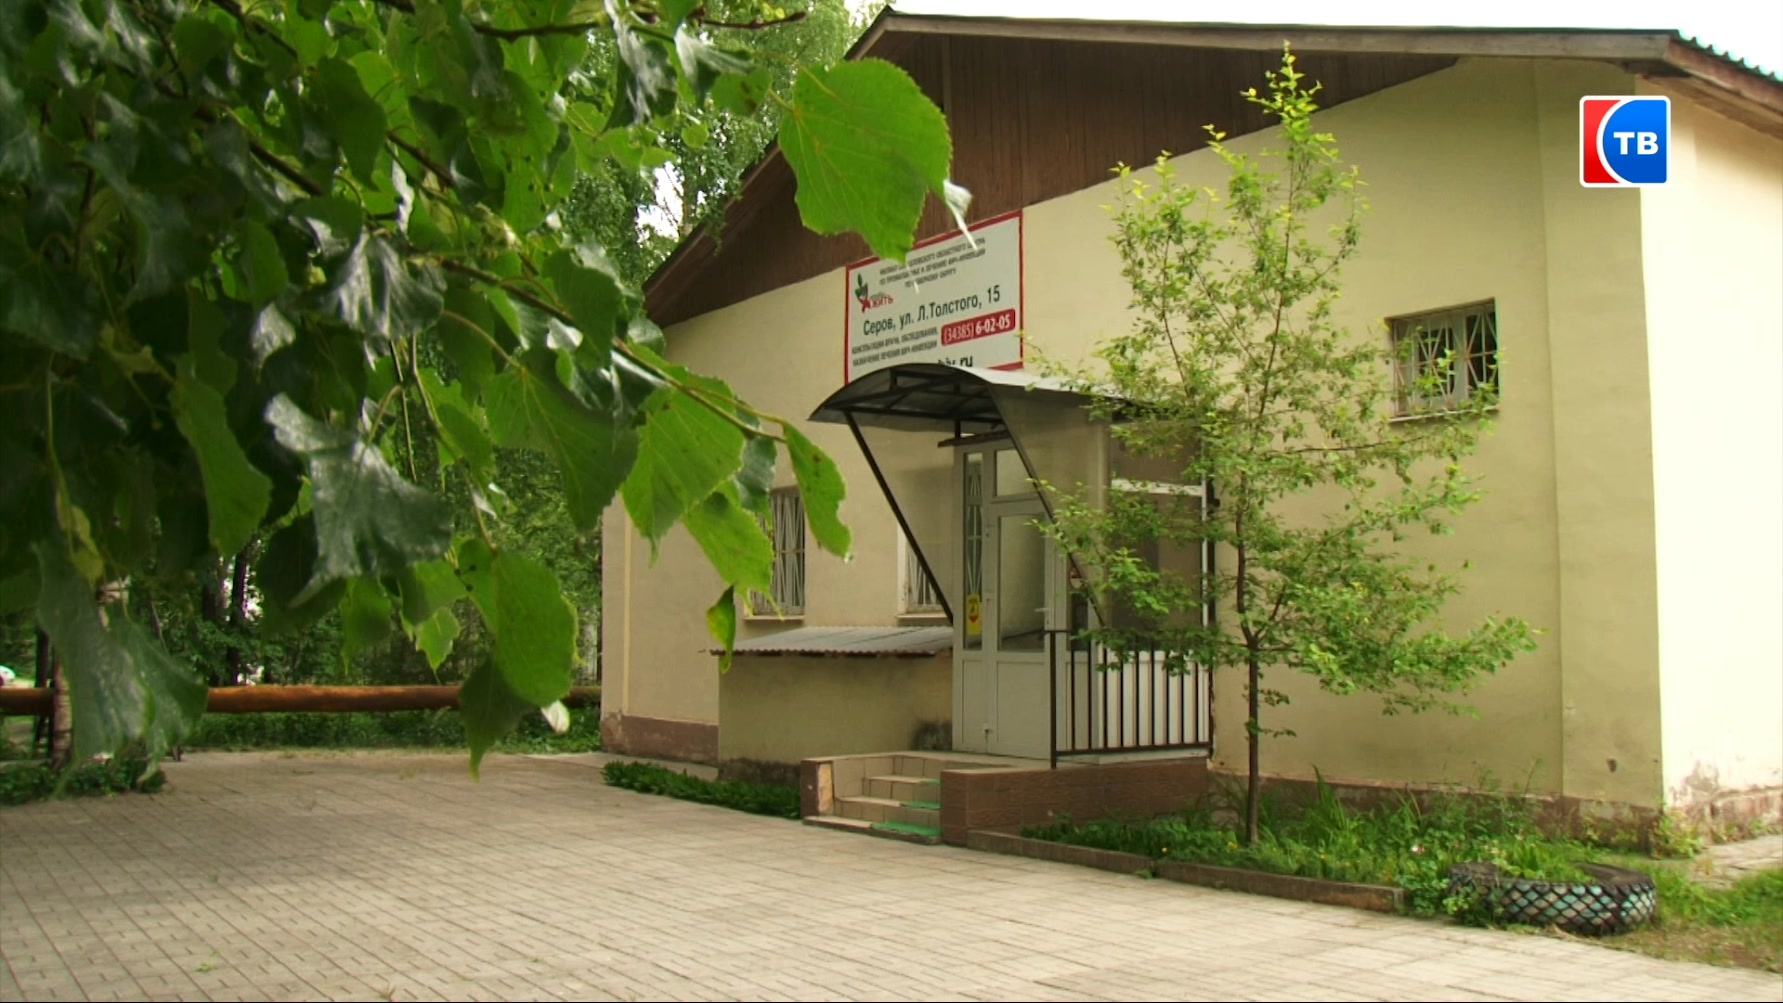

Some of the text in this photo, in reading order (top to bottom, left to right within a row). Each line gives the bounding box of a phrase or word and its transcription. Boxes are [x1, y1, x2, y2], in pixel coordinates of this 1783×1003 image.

[863, 285, 1000, 336] Серов, ул. Л.Толстого, 15
[944, 315, 1010, 343] (34385) 6-02-05
